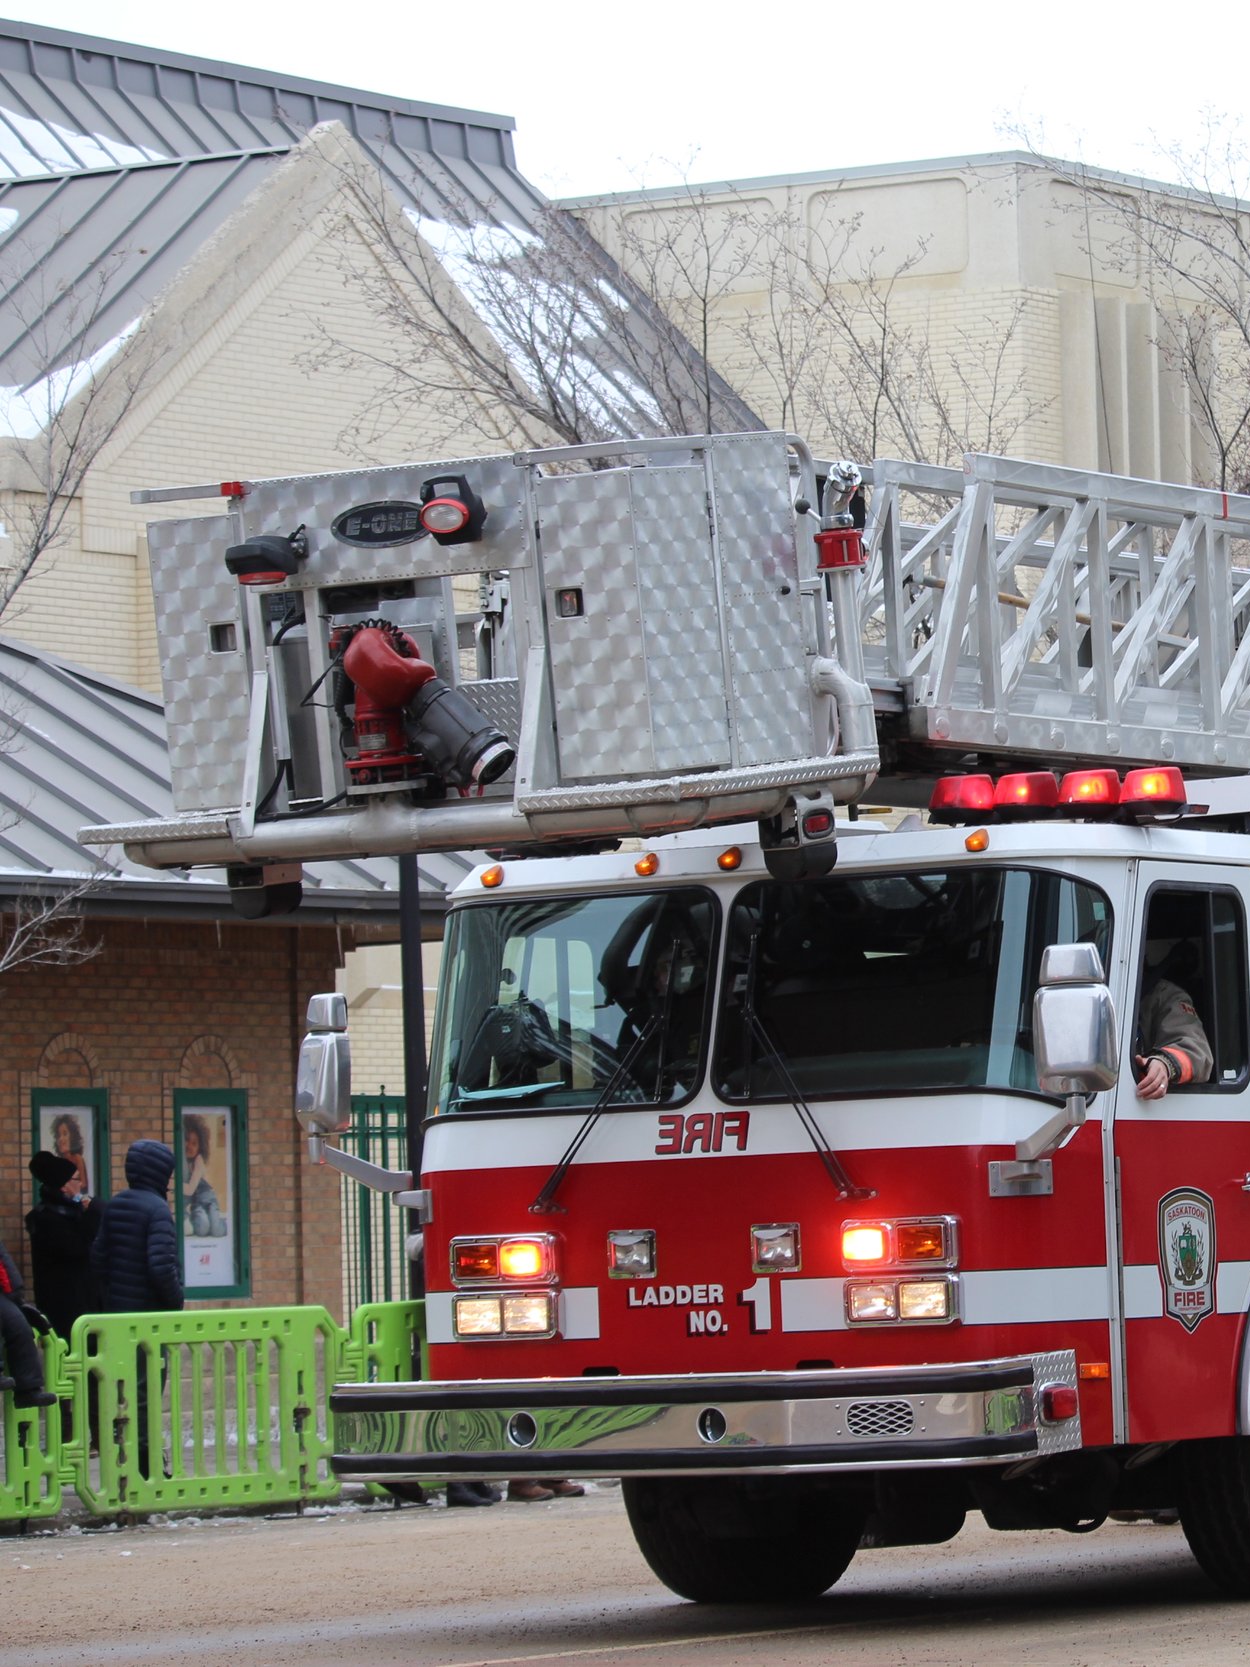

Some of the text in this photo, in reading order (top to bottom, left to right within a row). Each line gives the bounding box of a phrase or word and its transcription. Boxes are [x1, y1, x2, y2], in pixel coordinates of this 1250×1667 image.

[345, 510, 418, 537] E-ONE
[1167, 1205, 1206, 1221] SASKATOON
[627, 1284, 724, 1308] LADDER
[687, 1277, 772, 1336] NO. 1
[1173, 1290, 1206, 1307] FIRE
